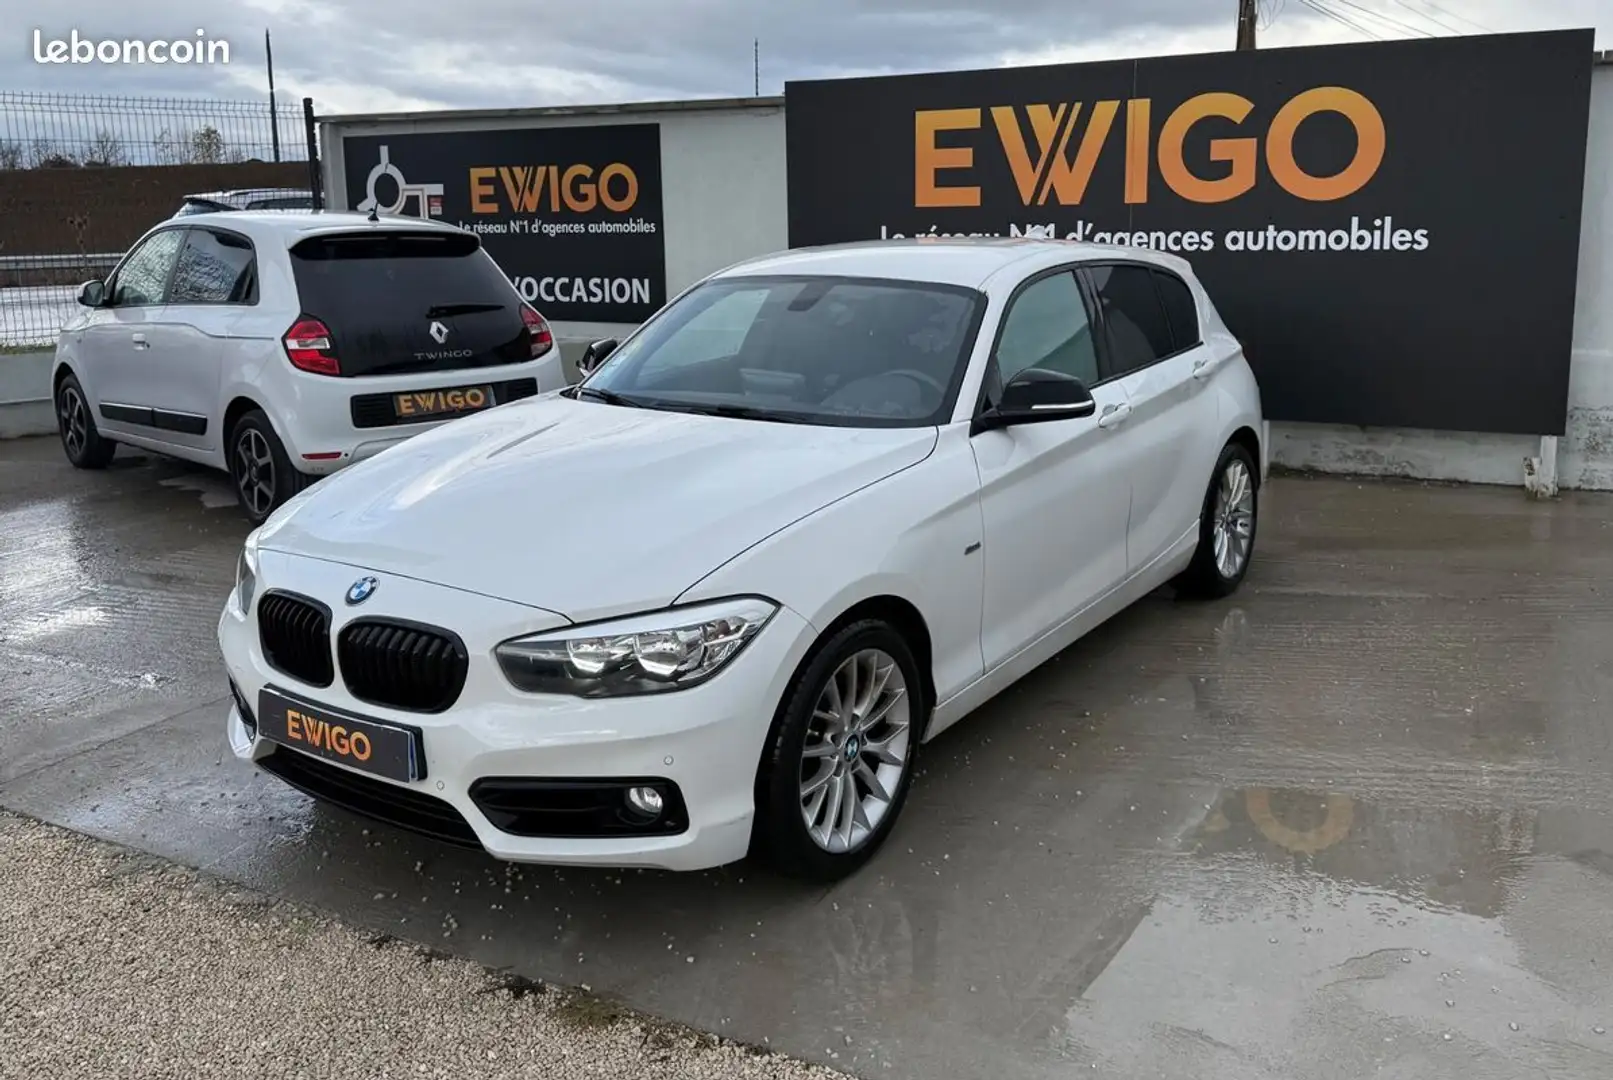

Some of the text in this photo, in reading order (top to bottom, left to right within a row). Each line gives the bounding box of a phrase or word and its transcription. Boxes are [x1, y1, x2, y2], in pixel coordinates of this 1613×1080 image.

[914, 86, 1386, 208] EWIGO
[469, 162, 639, 212] EWIGO
[473, 220, 507, 233] réseau
[531, 218, 585, 237] d'agences
[588, 217, 656, 234] automobiles
[1224, 216, 1429, 251] automobiles
[514, 276, 650, 304] 'OCCASION
[413, 349, 472, 360] TWINGO
[398, 388, 485, 414] EWIGO
[286, 709, 372, 762] EWIGO
